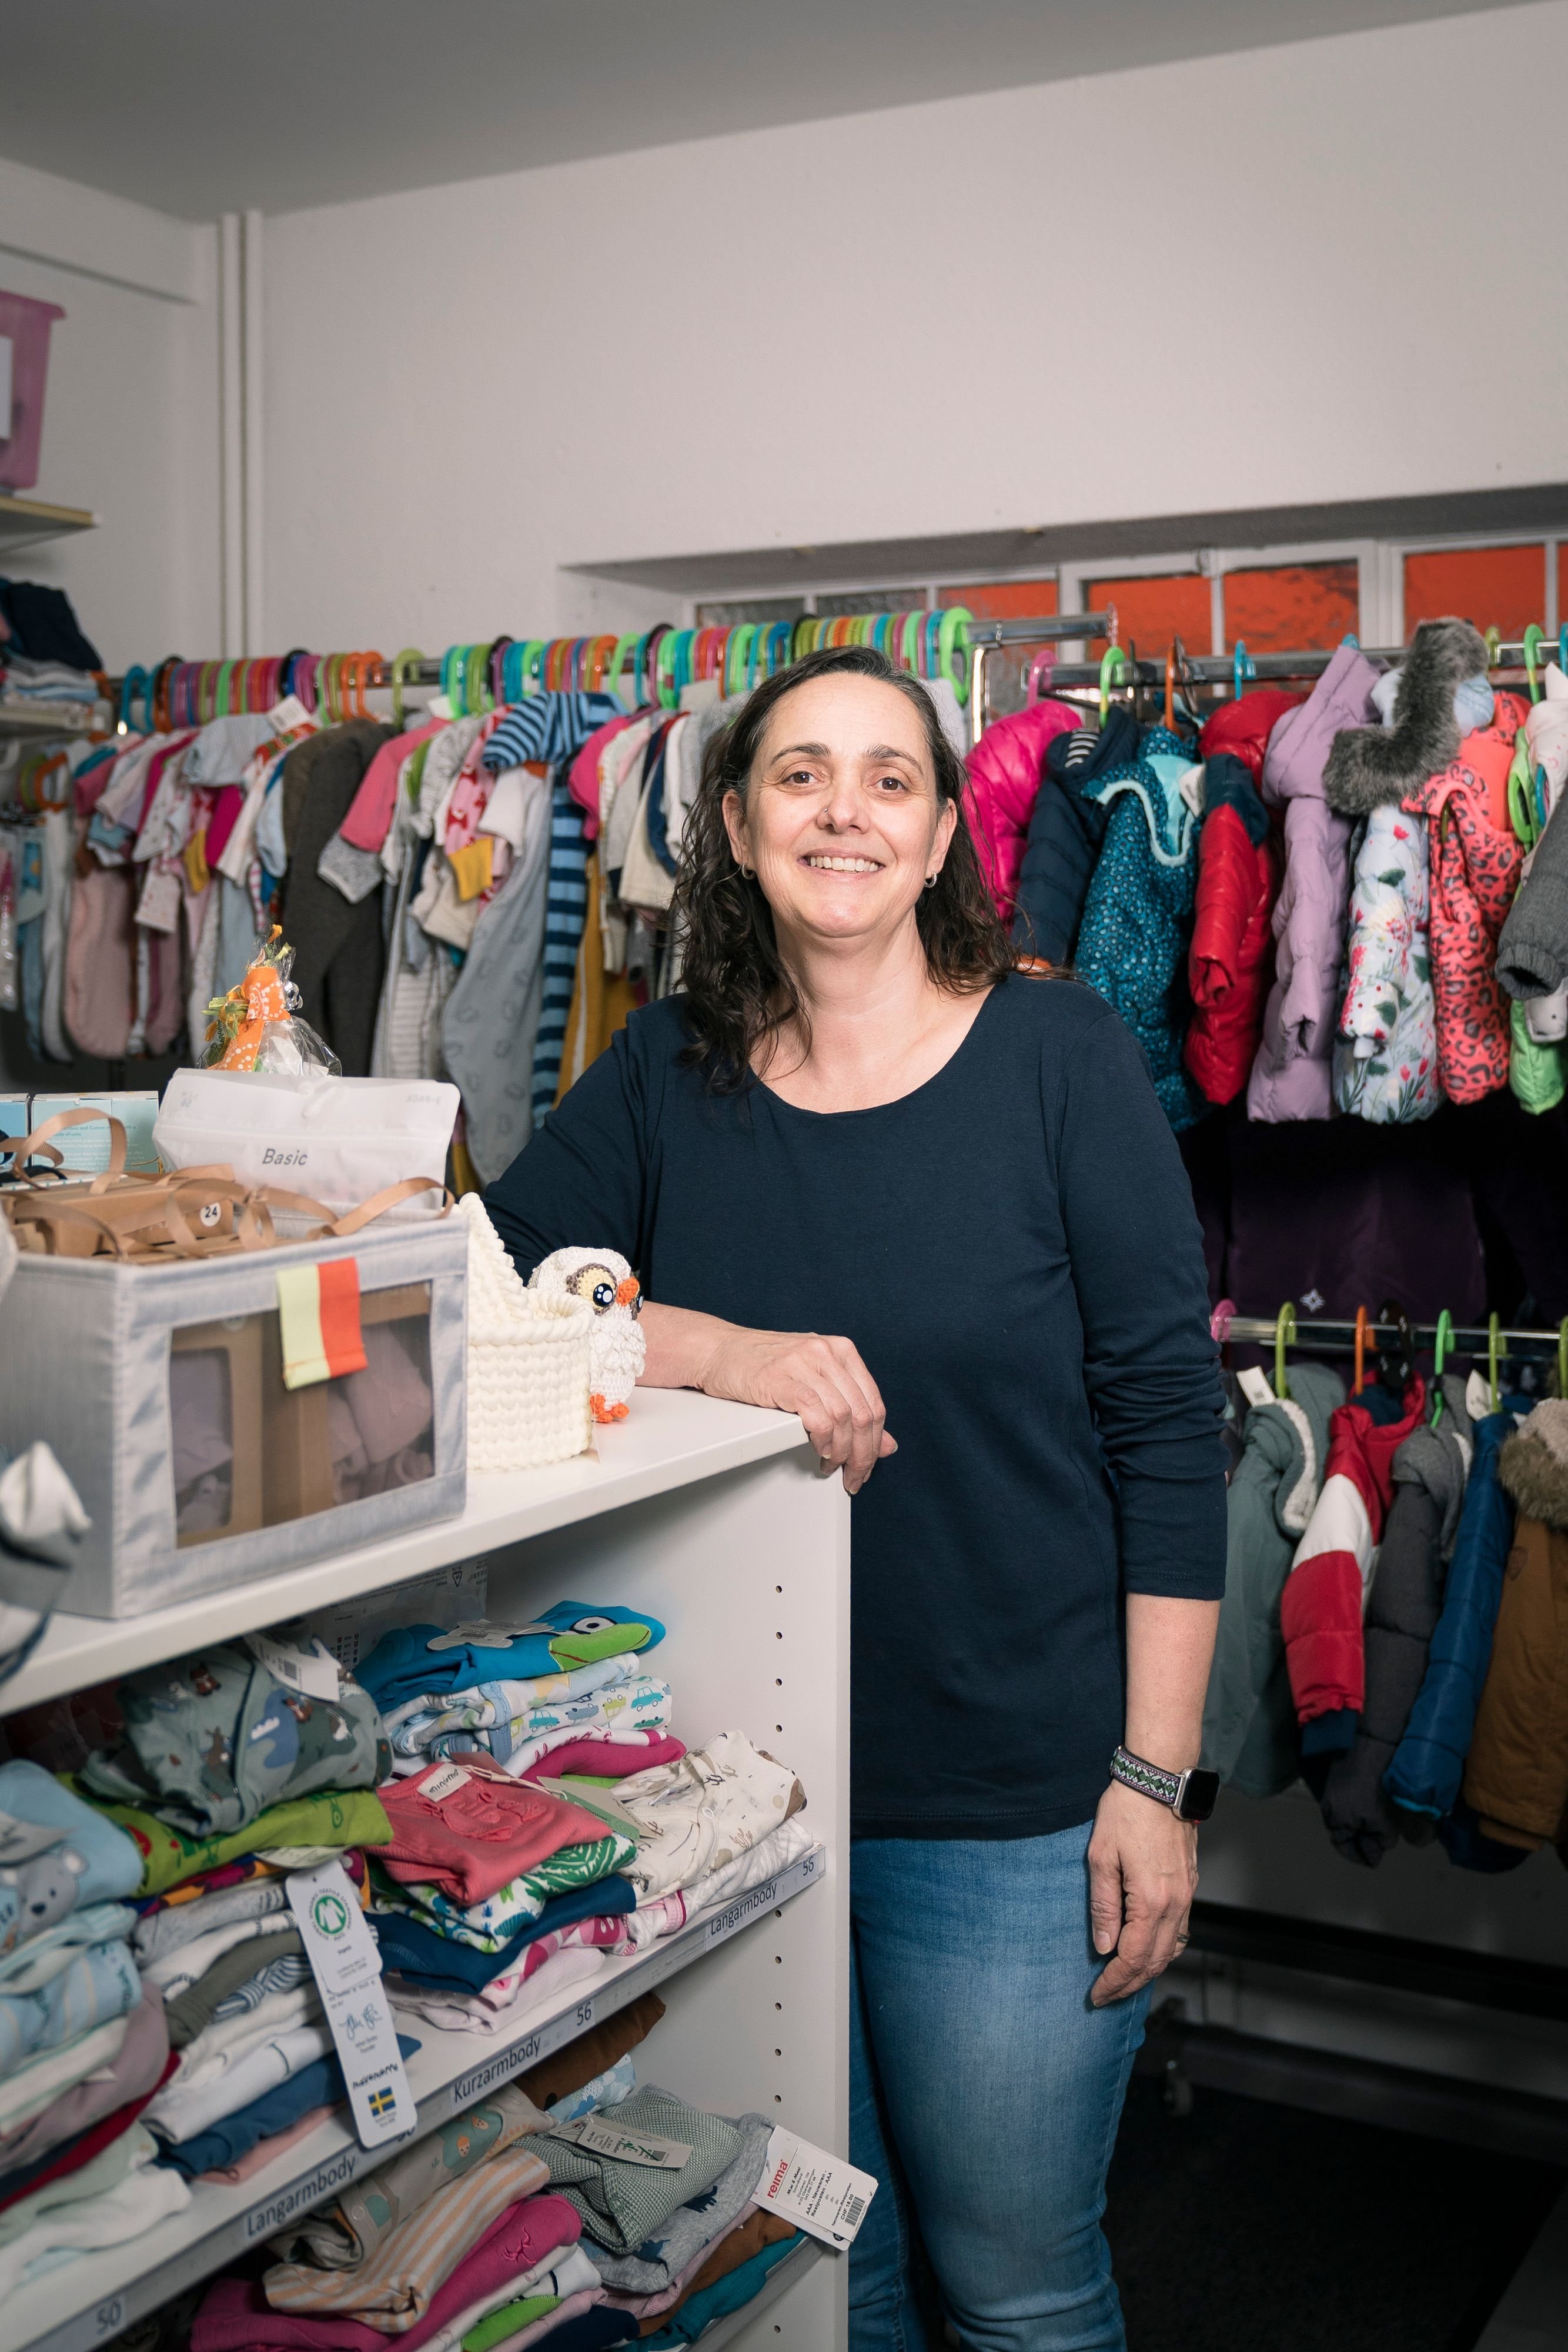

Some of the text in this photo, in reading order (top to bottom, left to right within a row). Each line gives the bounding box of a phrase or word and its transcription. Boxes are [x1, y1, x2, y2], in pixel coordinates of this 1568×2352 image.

[262, 1148, 307, 1165] Basic
[205, 1206, 218, 1218] 24
[711, 1856, 814, 1936] Langarmbody 56
[454, 2002, 591, 2103] Kurzarmbody 56
[246, 2155, 356, 2236] Langarmbody
[767, 2161, 788, 2199] reima
[812, 2173, 826, 2199] Neuwaren
[811, 2187, 826, 2217] Restposten
[845, 2194, 854, 2208] 18.00
[96, 2300, 122, 2335] 50
